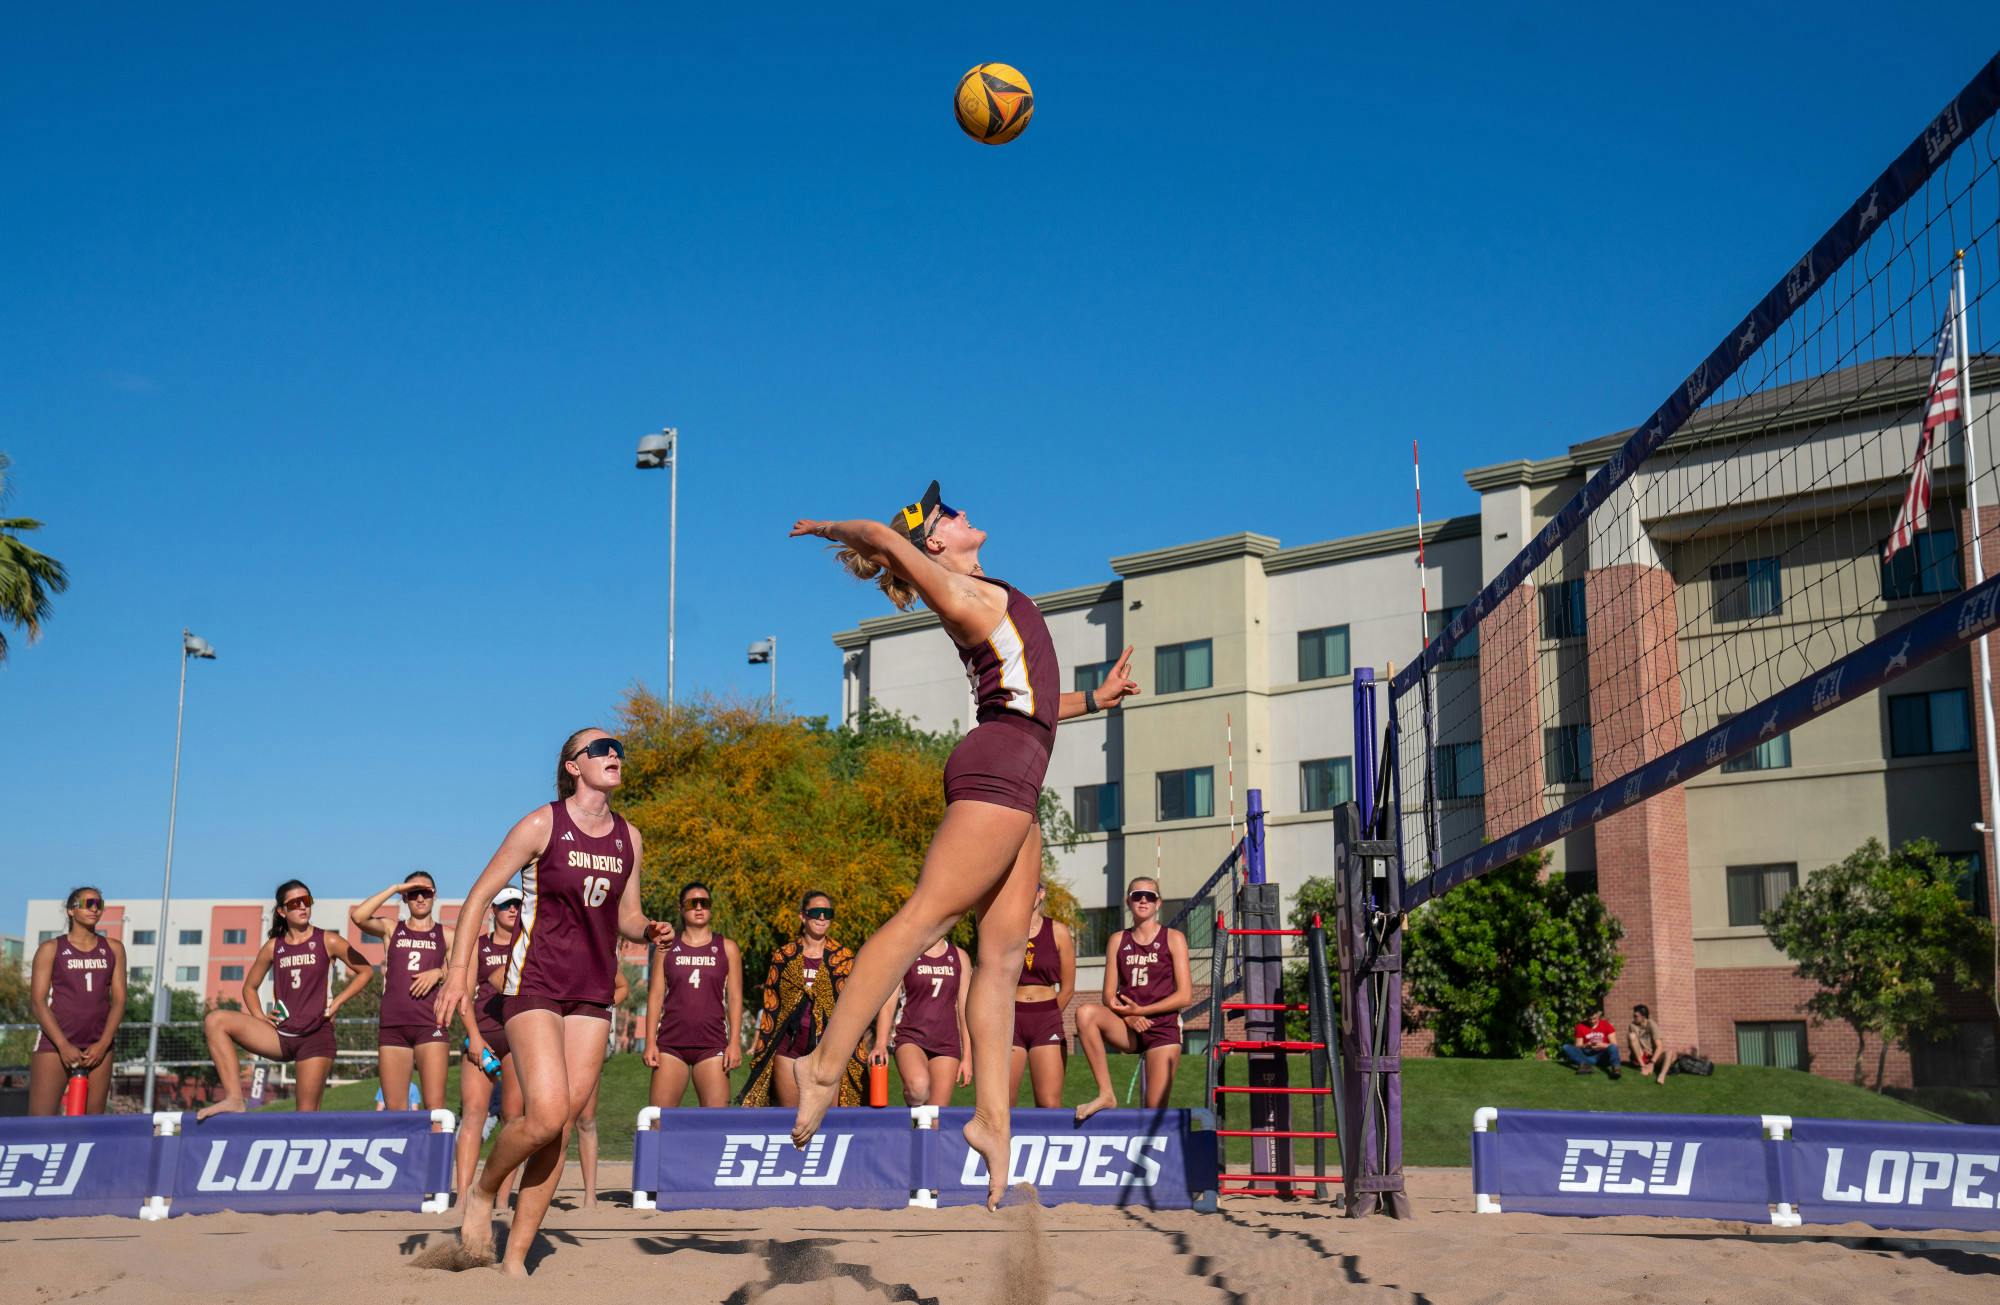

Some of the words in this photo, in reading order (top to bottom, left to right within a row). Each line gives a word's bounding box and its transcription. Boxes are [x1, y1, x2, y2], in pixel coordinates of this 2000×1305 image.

[1958, 583, 2000, 639] GCU
[1812, 665, 1846, 712] GCU
[567, 850, 592, 869] SUN
[591, 854, 624, 874] DEVILS
[583, 875, 611, 908] 16
[395, 938, 412, 949] SUN
[411, 939, 437, 951] DEVILS
[67, 958, 84, 970] SUN
[84, 958, 108, 969] DEVILS
[279, 955, 292, 969] SUN
[291, 953, 316, 967] DEVILS
[407, 951, 422, 971] 2
[485, 954, 502, 967] SUN
[675, 955, 691, 966] SUN
[691, 955, 716, 967] DEVILS
[917, 964, 933, 975] SUN
[932, 965, 955, 977] DEVILS
[84, 971, 93, 992] 1
[290, 968, 302, 989] 3
[688, 968, 701, 989] 4
[1131, 966, 1149, 987] 15
[931, 977, 944, 998] 7
[0, 1142, 95, 1197] CU
[197, 1138, 408, 1192] LOPES
[714, 1134, 854, 1187] GCU
[960, 1135, 1168, 1187] LOPES
[1558, 1138, 1703, 1196] GCU
[1822, 1147, 2000, 1210] LOPE
